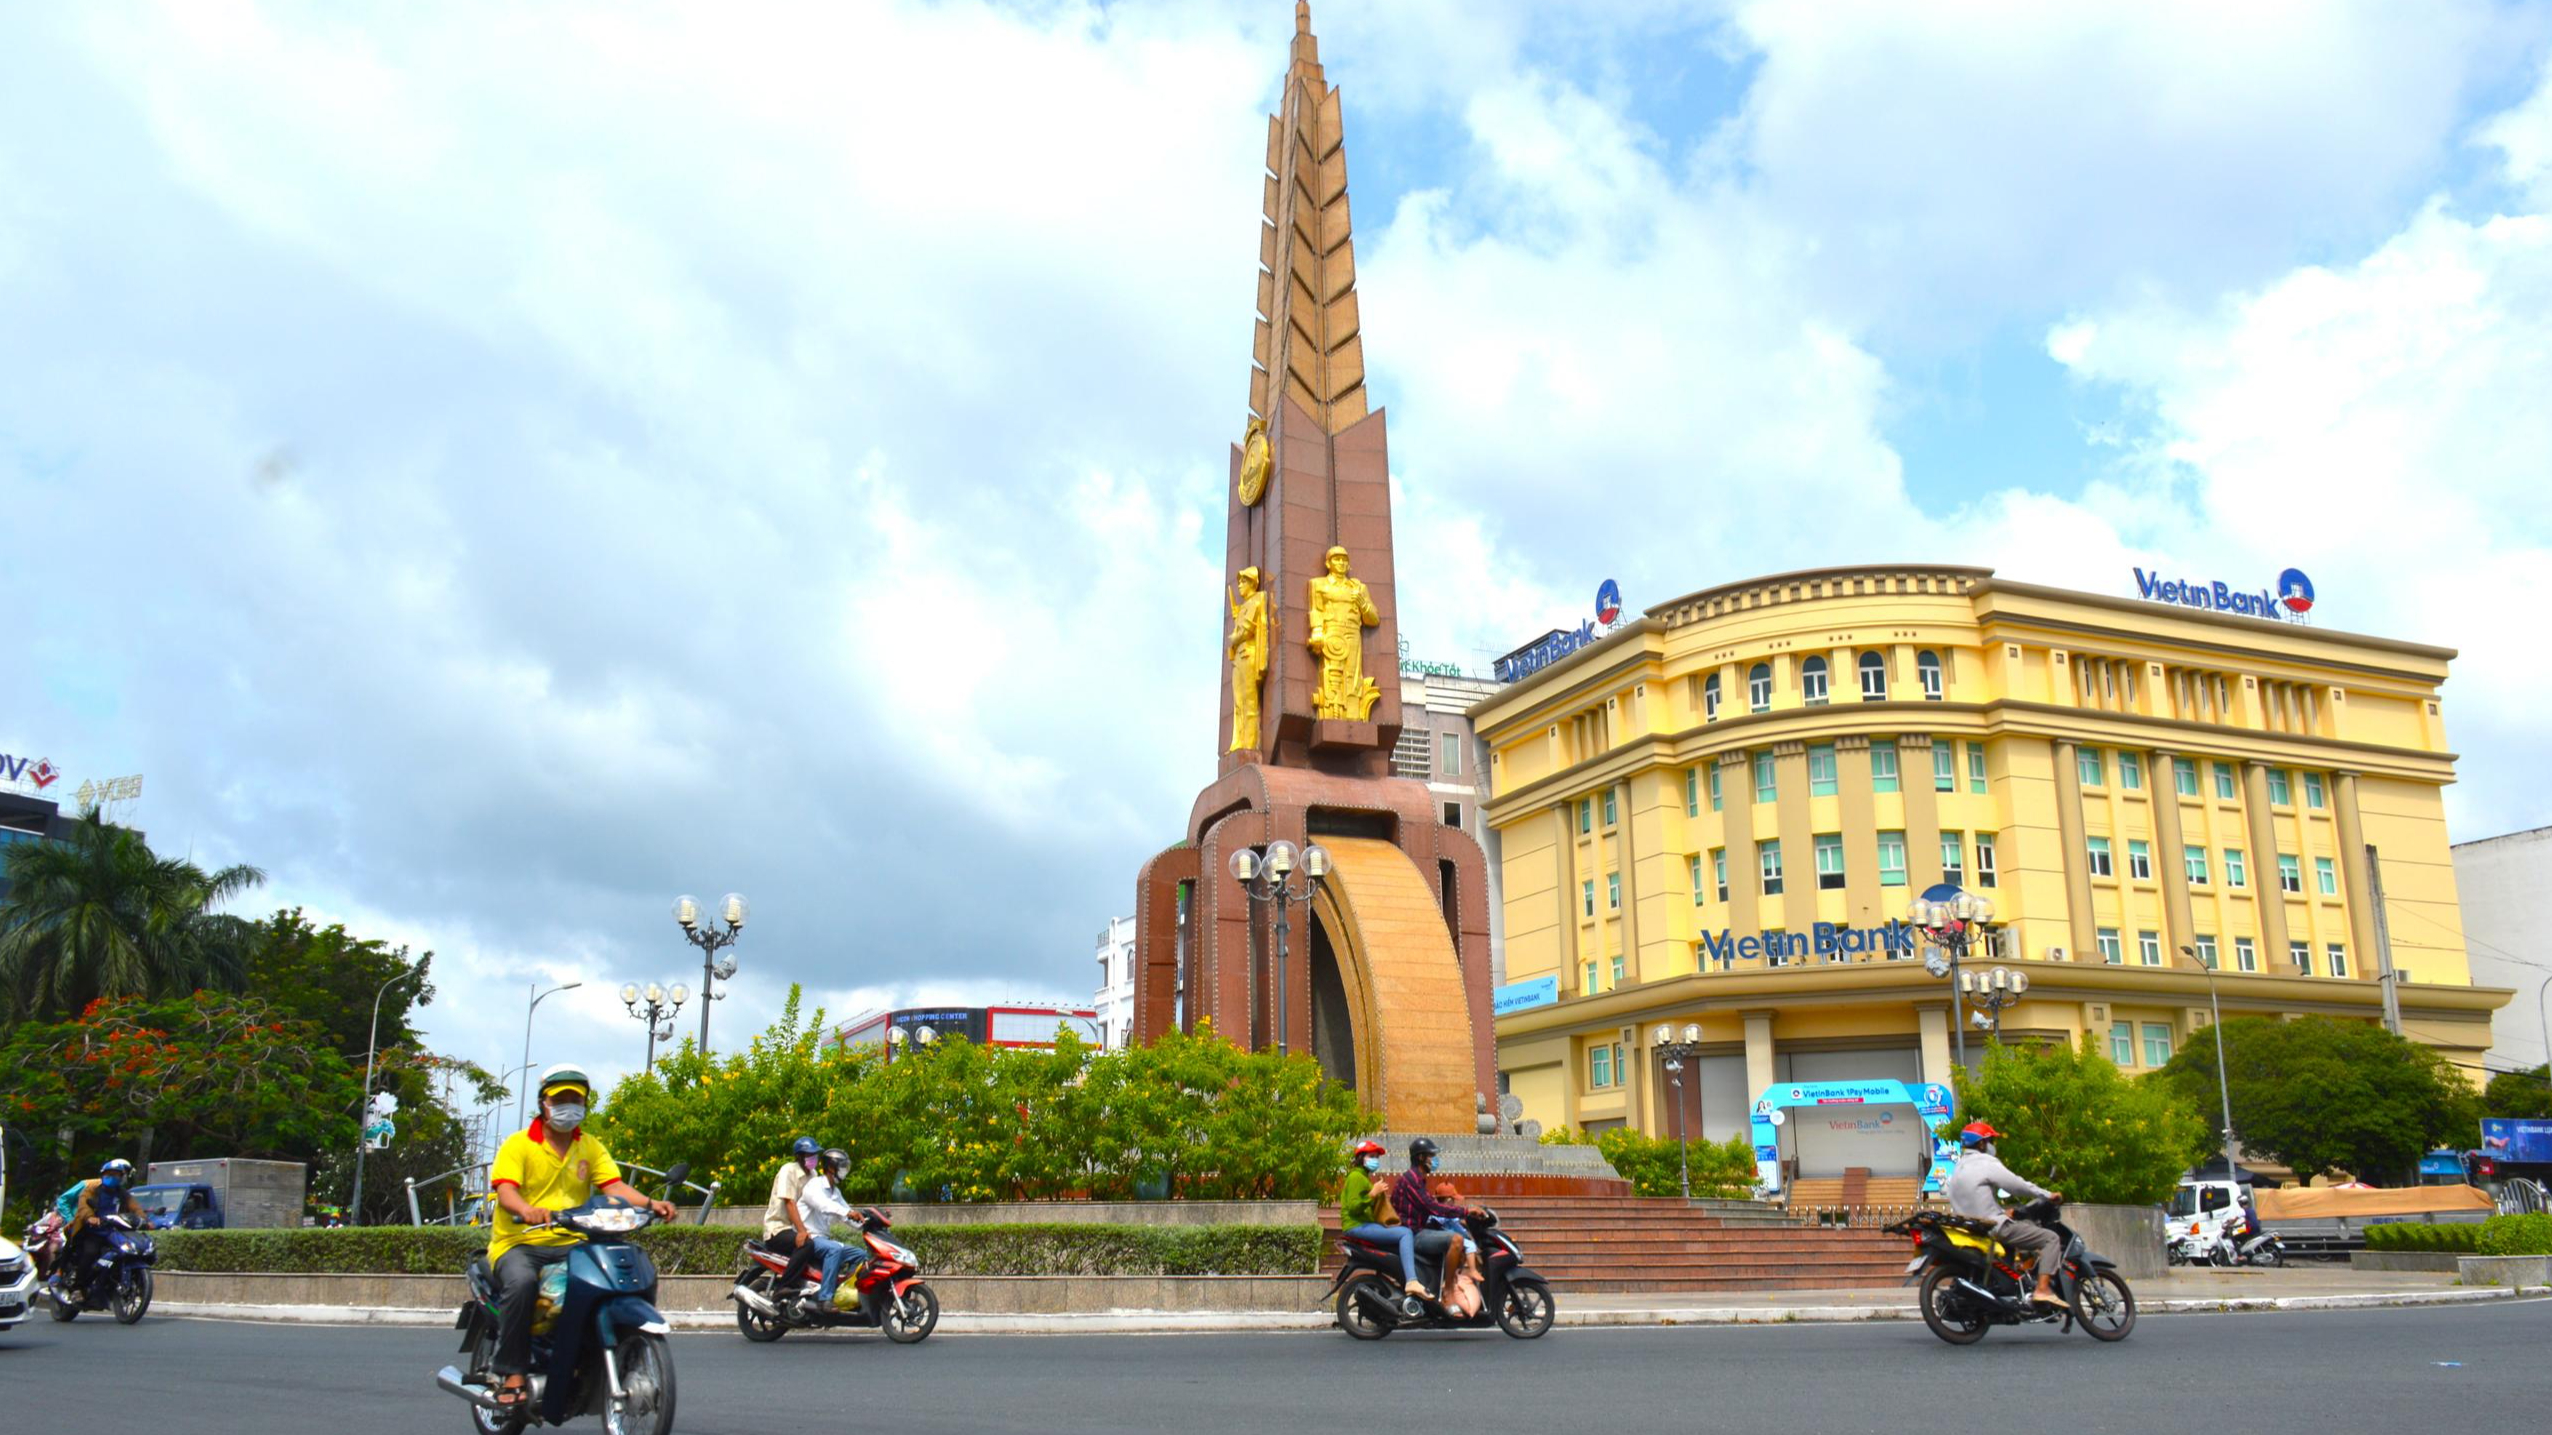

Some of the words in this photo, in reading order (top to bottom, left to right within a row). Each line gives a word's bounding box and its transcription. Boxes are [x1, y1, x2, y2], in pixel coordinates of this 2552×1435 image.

[2133, 567, 2281, 619] VietinBank
[1505, 618, 1595, 683] VietinBank
[1701, 917, 1915, 961] VietinBank
[1514, 993, 1541, 1005] VIETINBANK
[941, 1012, 967, 1020] CENTER
[1803, 1089, 1845, 1098] VietinBank
[1829, 1119, 1880, 1130] VietinBank
